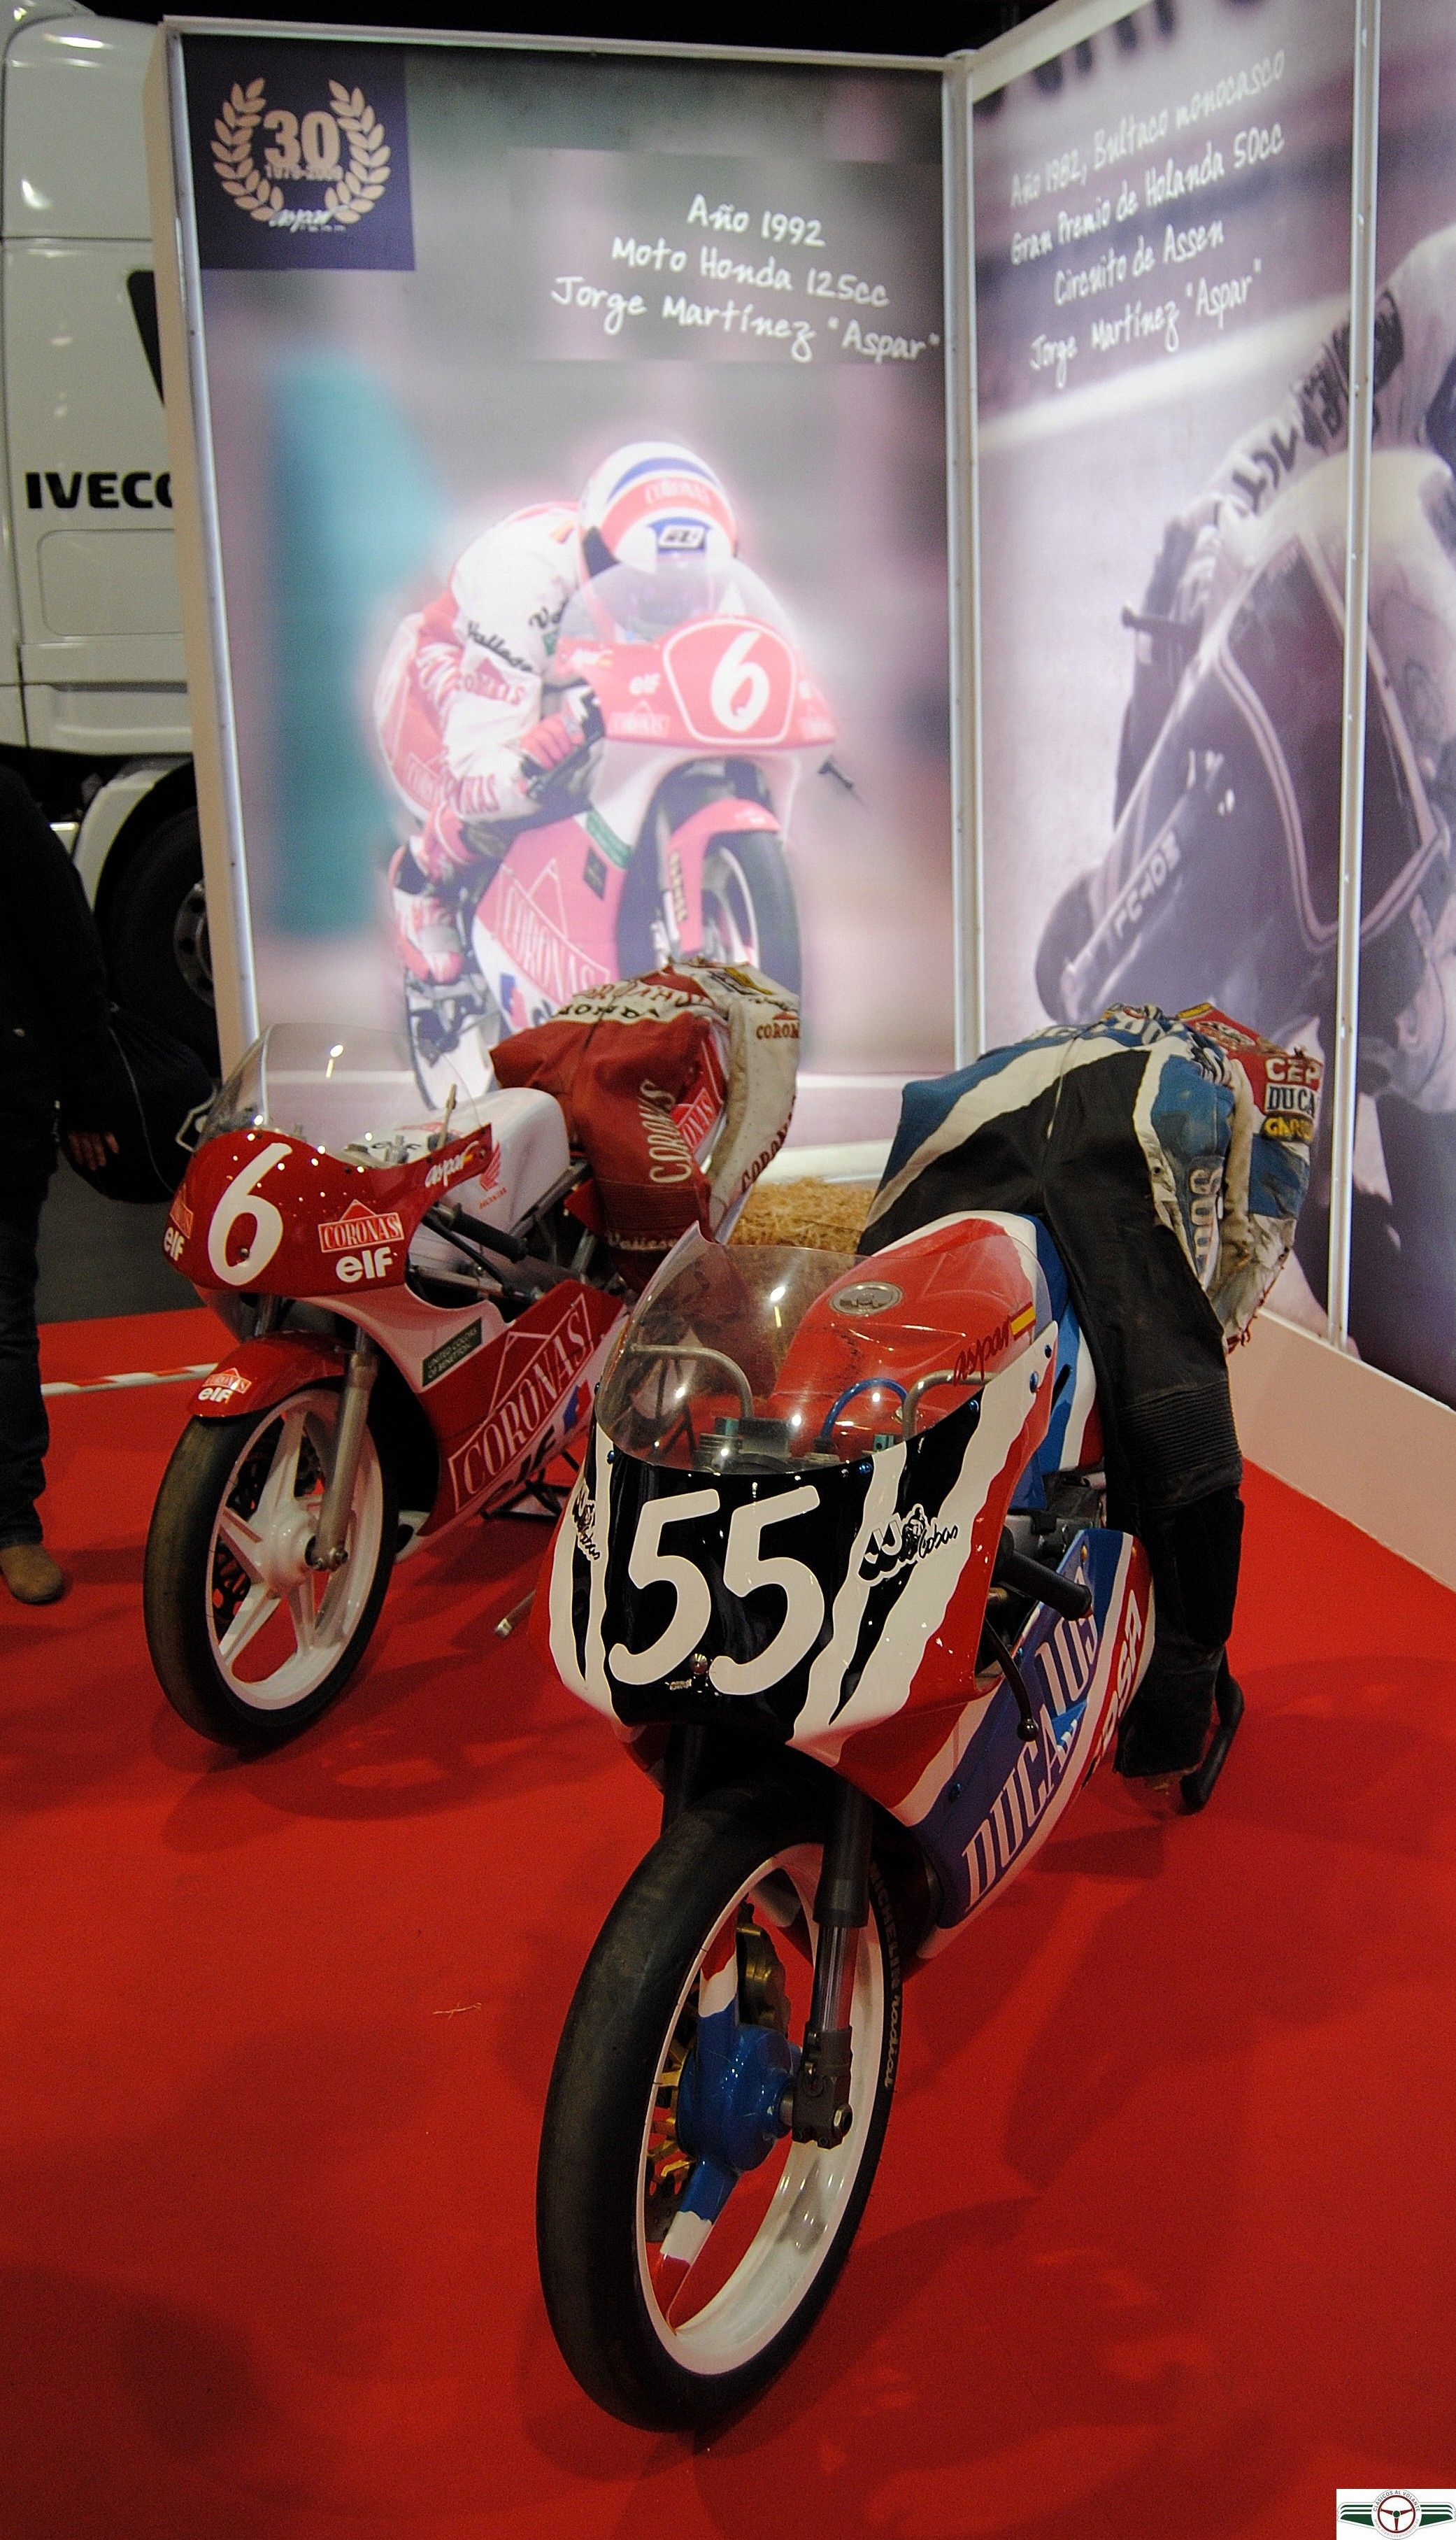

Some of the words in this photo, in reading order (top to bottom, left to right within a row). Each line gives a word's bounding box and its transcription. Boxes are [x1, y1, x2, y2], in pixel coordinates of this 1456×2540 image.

[264, 110, 340, 169] 30
[1010, 173, 1041, 208] Año
[1092, 110, 1169, 171] Bultaco
[686, 193, 749, 233] Año
[761, 211, 826, 248] 1992
[1011, 228, 1053, 265] Gran
[1057, 195, 1111, 245] Premio
[1115, 179, 1139, 222] de
[1145, 140, 1225, 208] Holanda
[1233, 122, 1286, 169] 50cc
[611, 236, 687, 273] Moto
[699, 245, 793, 292] Honda
[807, 269, 890, 308] 125cc
[1053, 246, 1127, 306] Circuito
[1132, 234, 1156, 278] de
[1162, 219, 1225, 264] Assen
[550, 276, 648, 335] Jorge
[662, 295, 817, 363] Martínez
[1029, 334, 1079, 390] Jorge
[709, 630, 769, 733] 6
[164, 1226, 185, 1261] elf
[208, 1142, 293, 1286] 6
[323, 1217, 400, 1250] CORONAS
[336, 1246, 393, 1283] elf
[462, 1310, 592, 1496] CORONAS
[608, 1485, 825, 1696] 55
